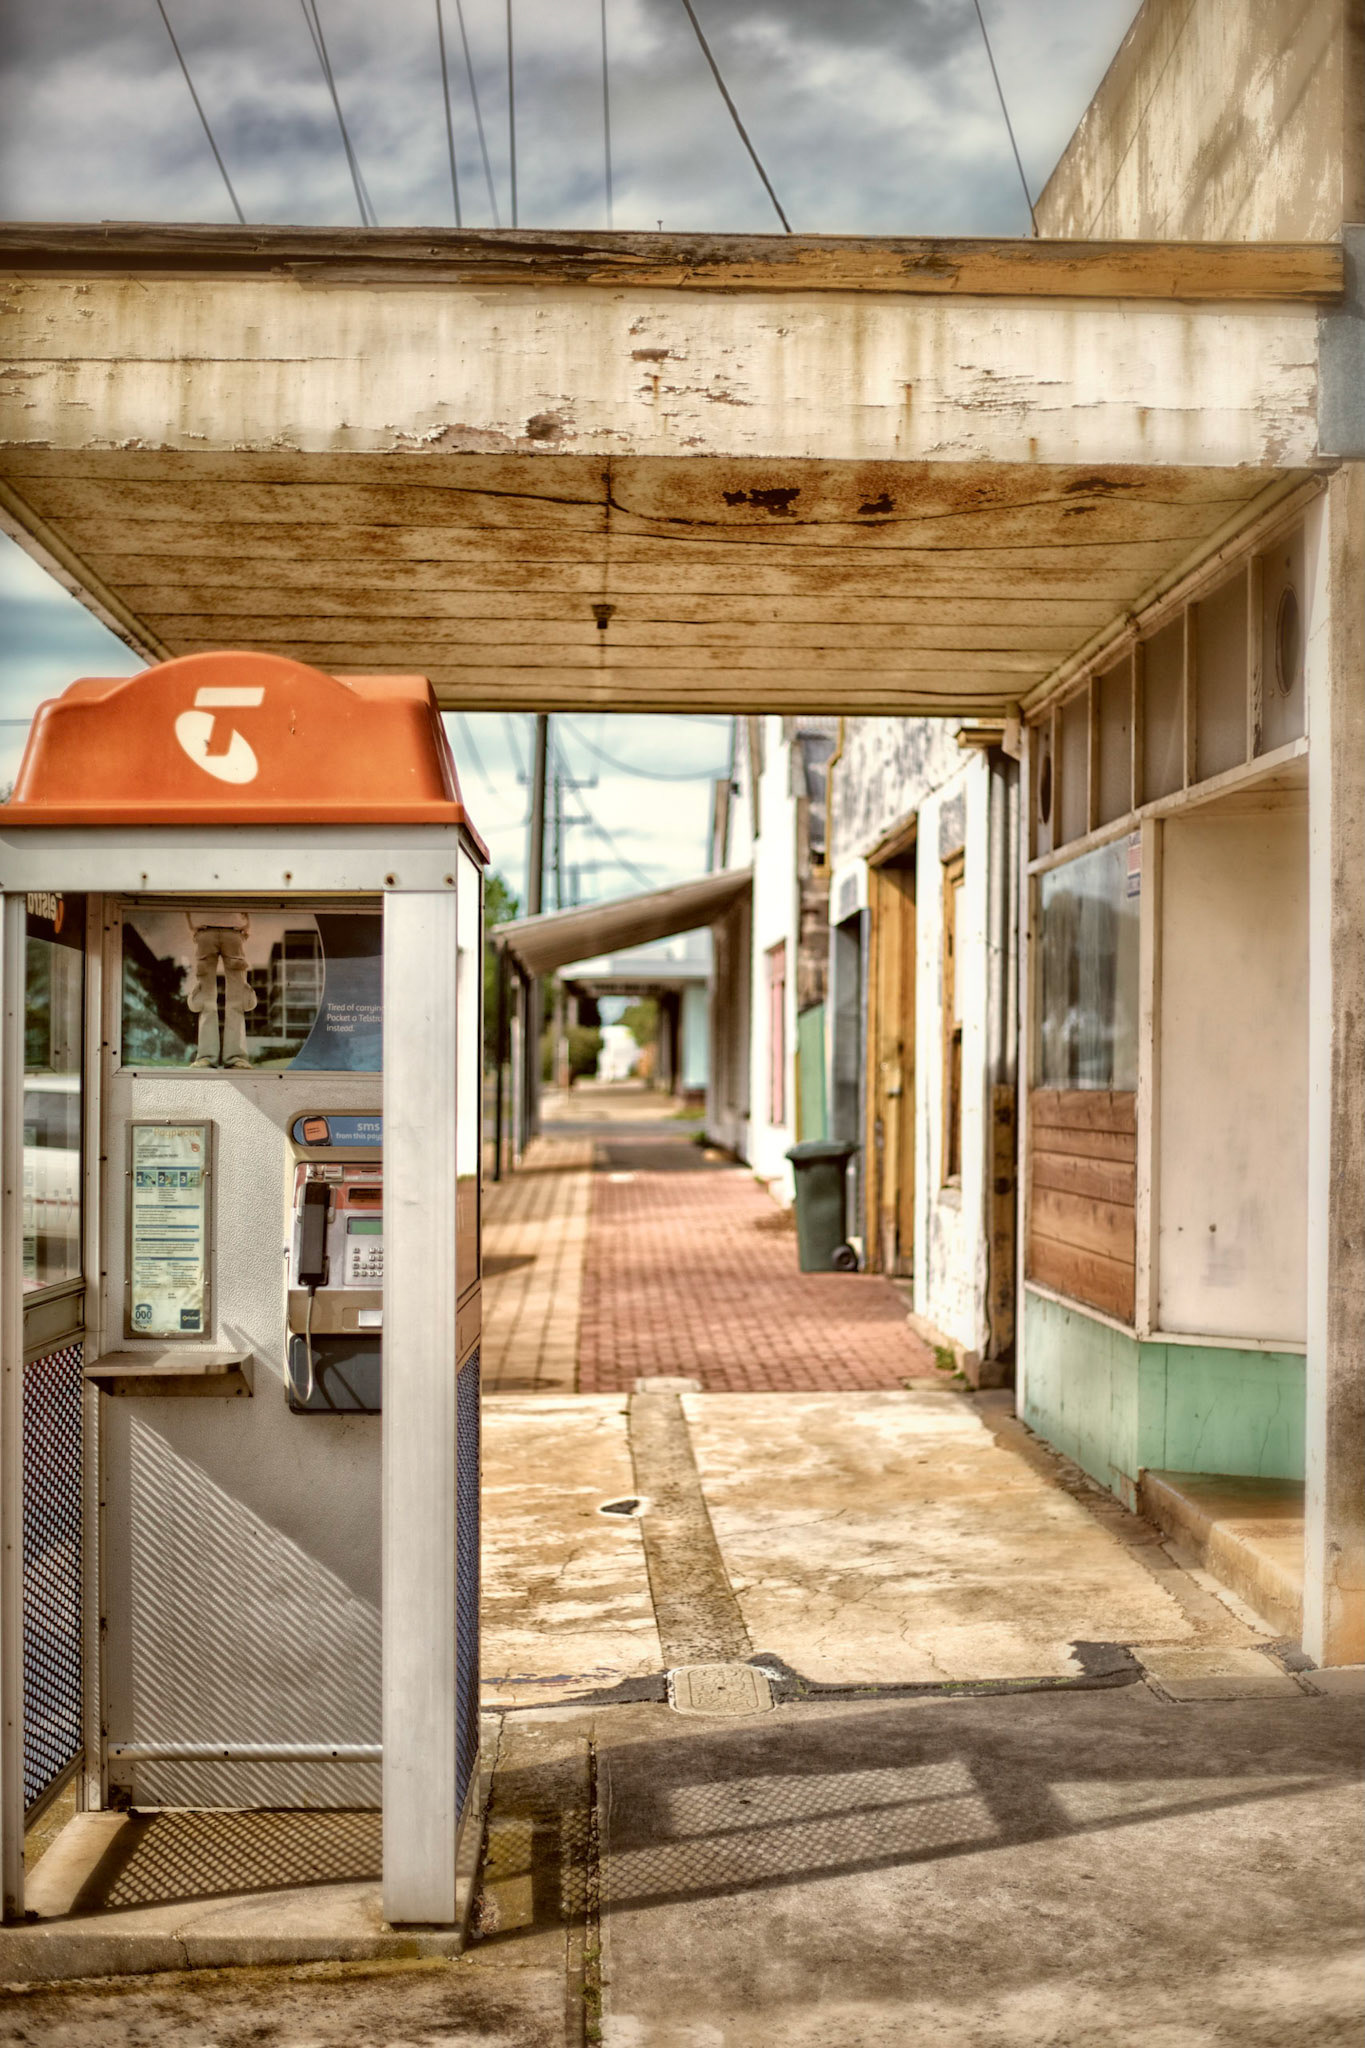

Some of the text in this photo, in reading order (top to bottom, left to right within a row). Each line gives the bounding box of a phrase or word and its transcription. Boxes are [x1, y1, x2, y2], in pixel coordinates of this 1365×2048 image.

[327, 1003, 384, 1015] Tired of carryin
[326, 1013, 350, 1022] Pocket
[326, 1023, 355, 1033] instead.
[357, 1122, 381, 1132] sms
[336, 1132, 353, 1140] from
[353, 1132, 366, 1140] this
[137, 1175, 186, 1184] 1 2 3
[135, 1310, 153, 1321] 000
